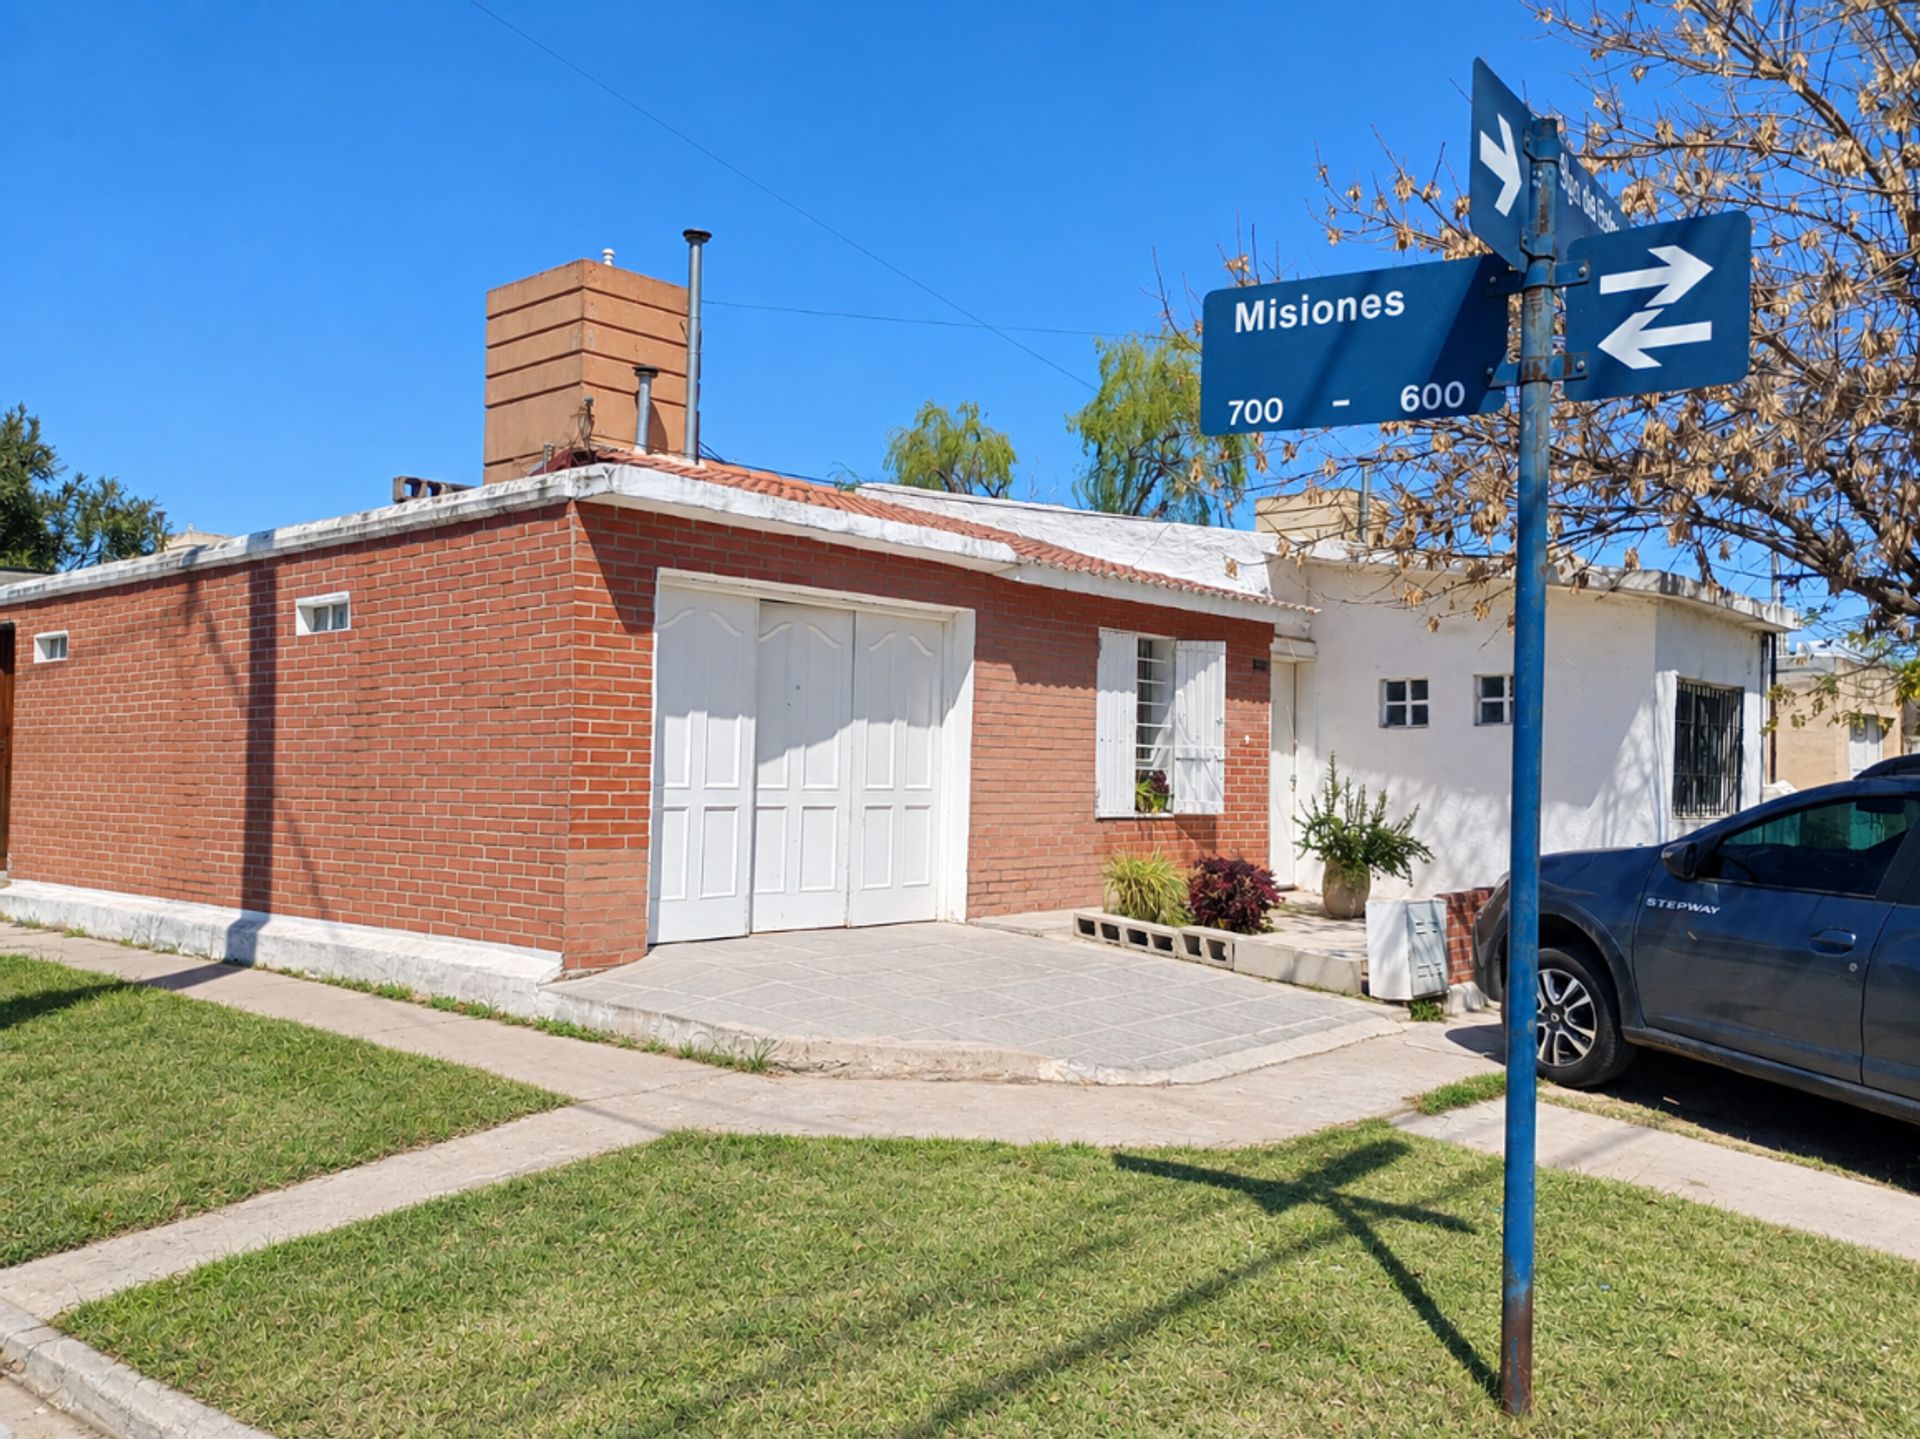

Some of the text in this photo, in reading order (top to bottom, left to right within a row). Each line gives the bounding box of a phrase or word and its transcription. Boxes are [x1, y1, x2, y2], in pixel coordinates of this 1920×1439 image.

[1234, 290, 1406, 333] Misiones
[1227, 397, 1284, 427] 700
[1400, 380, 1466, 413] 600
[1645, 897, 1720, 915] STEPWAY
